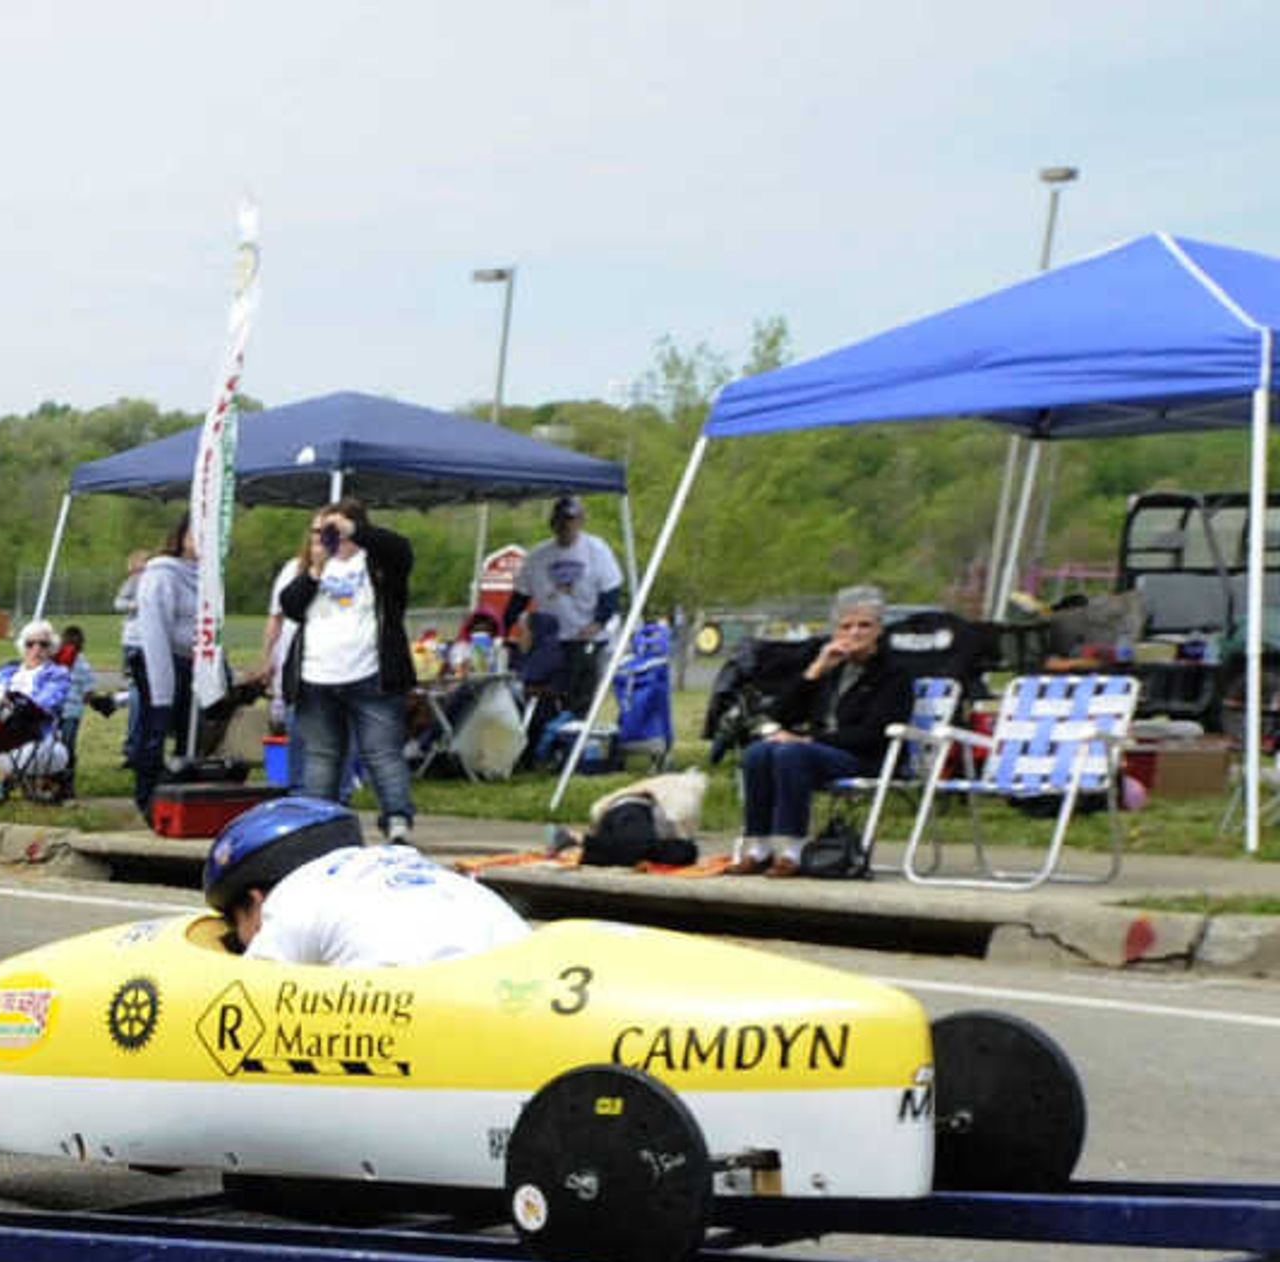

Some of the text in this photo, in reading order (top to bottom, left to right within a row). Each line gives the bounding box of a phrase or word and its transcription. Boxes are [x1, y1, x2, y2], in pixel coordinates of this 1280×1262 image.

[274, 979, 415, 1024] Rushing
[550, 966, 593, 1015] 3
[218, 1004, 243, 1051] R
[274, 1022, 396, 1059] Marine
[611, 1023, 851, 1071] CAMDYN
